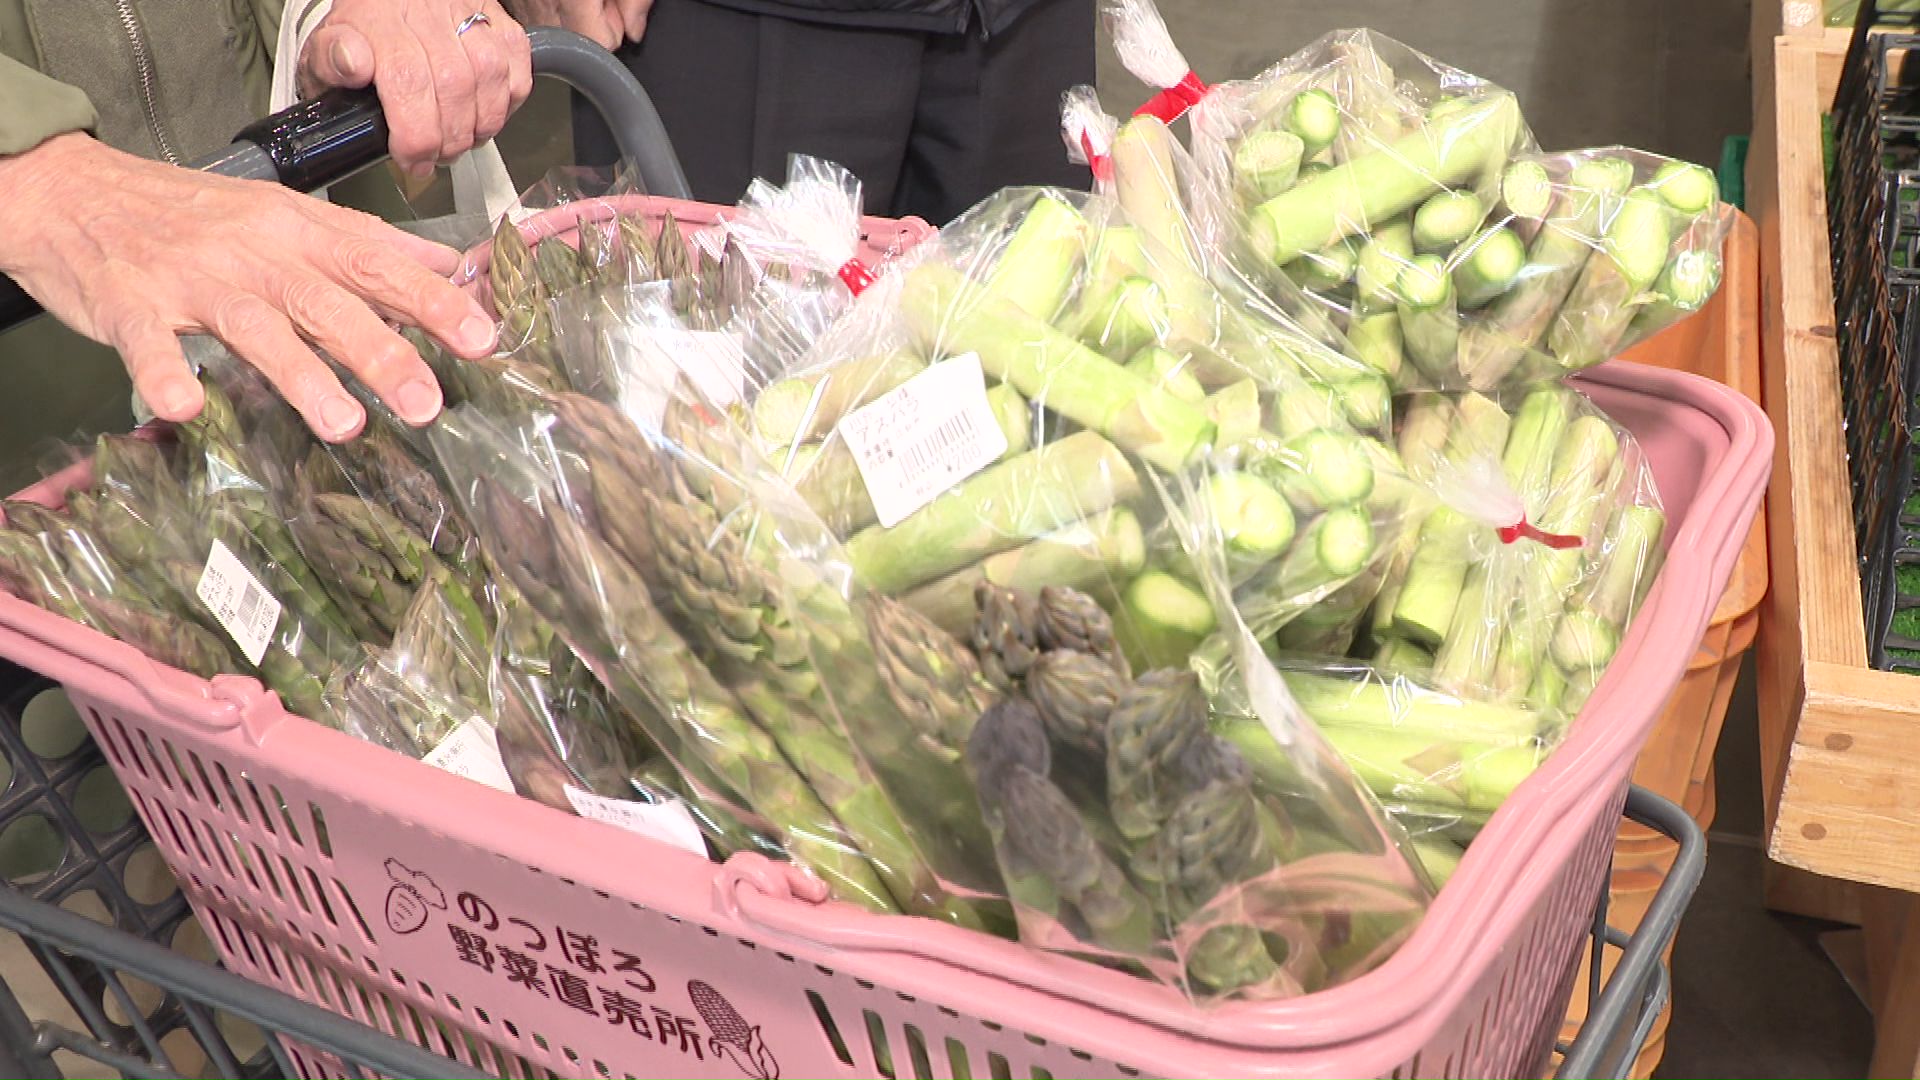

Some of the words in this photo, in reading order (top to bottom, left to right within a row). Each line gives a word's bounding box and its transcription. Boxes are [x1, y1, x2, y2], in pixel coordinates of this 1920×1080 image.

[447, 923, 704, 1060] 野菜直売所
[457, 891, 656, 992] のっぽろ
